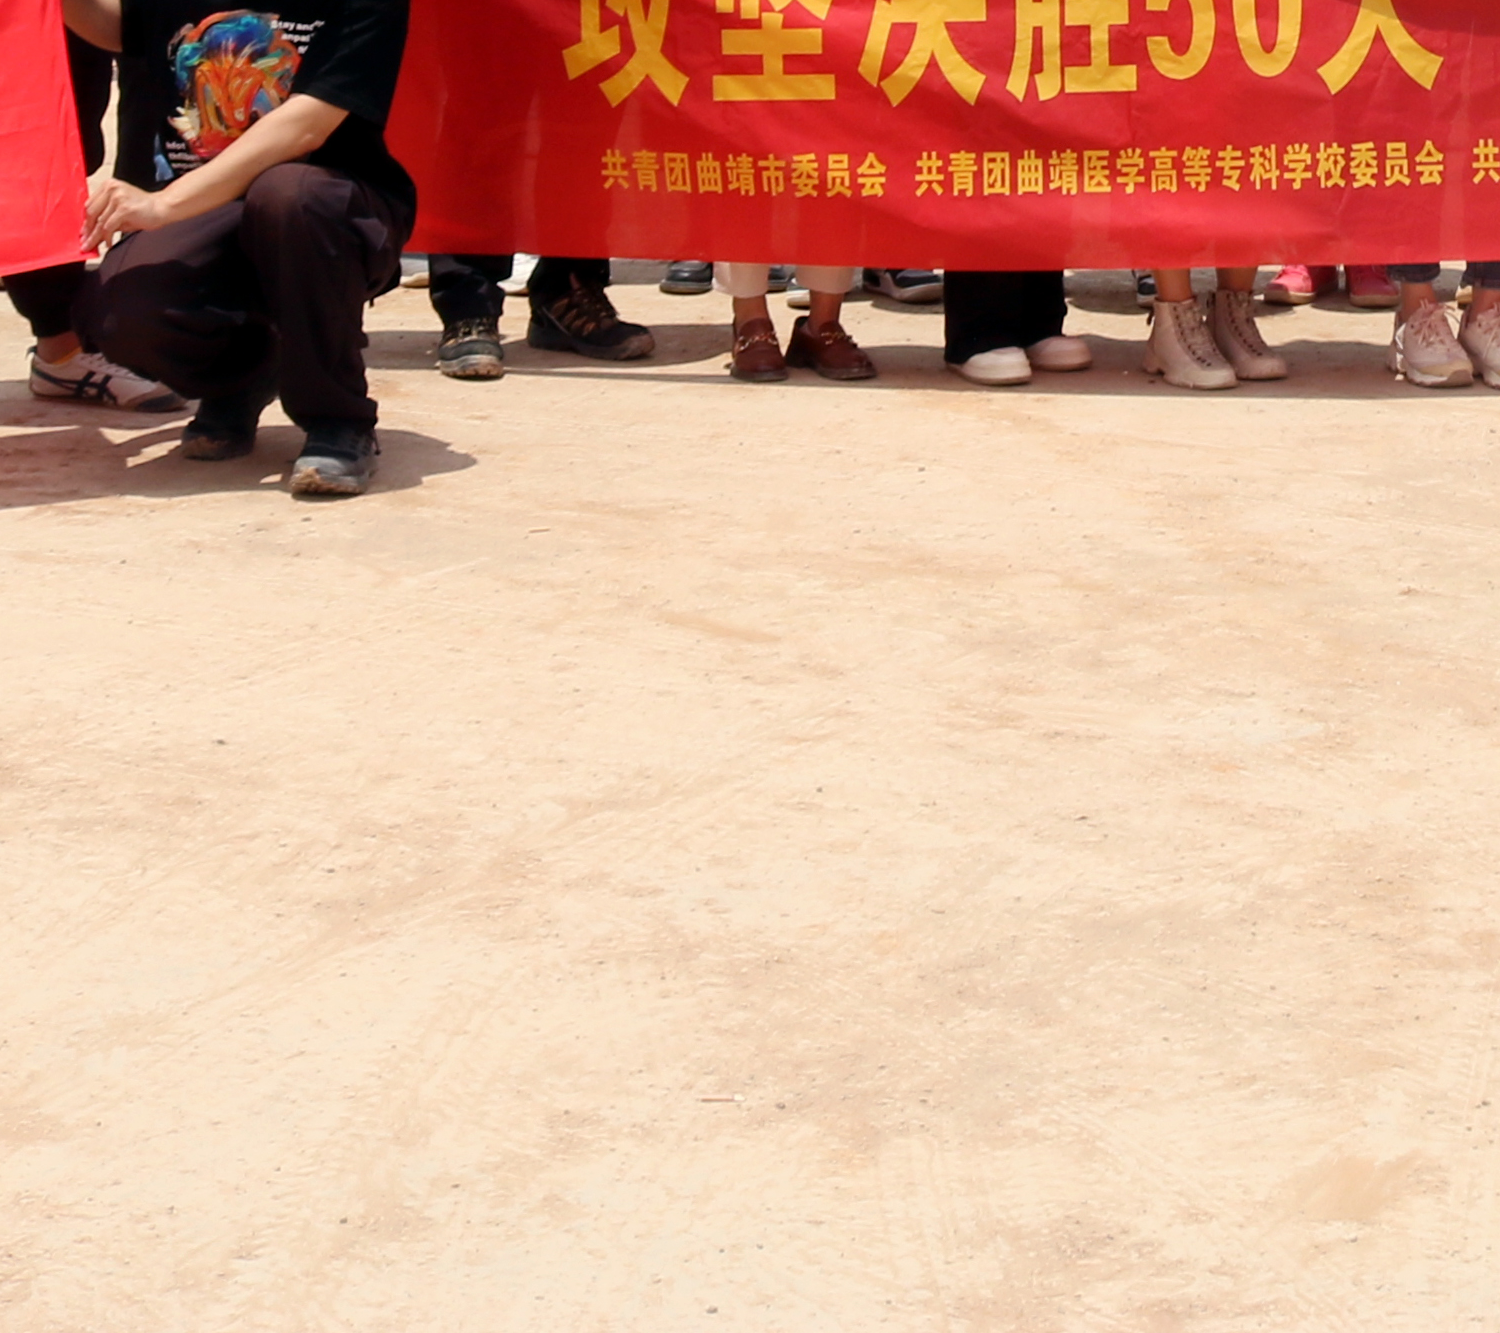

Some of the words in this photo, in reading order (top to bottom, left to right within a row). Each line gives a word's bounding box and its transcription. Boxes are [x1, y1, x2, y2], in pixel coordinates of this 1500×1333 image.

[601, 148, 888, 197] 共青团曲靖市委员会
[915, 139, 1444, 197] 共青团曲靖医学高等专科学校委员会
